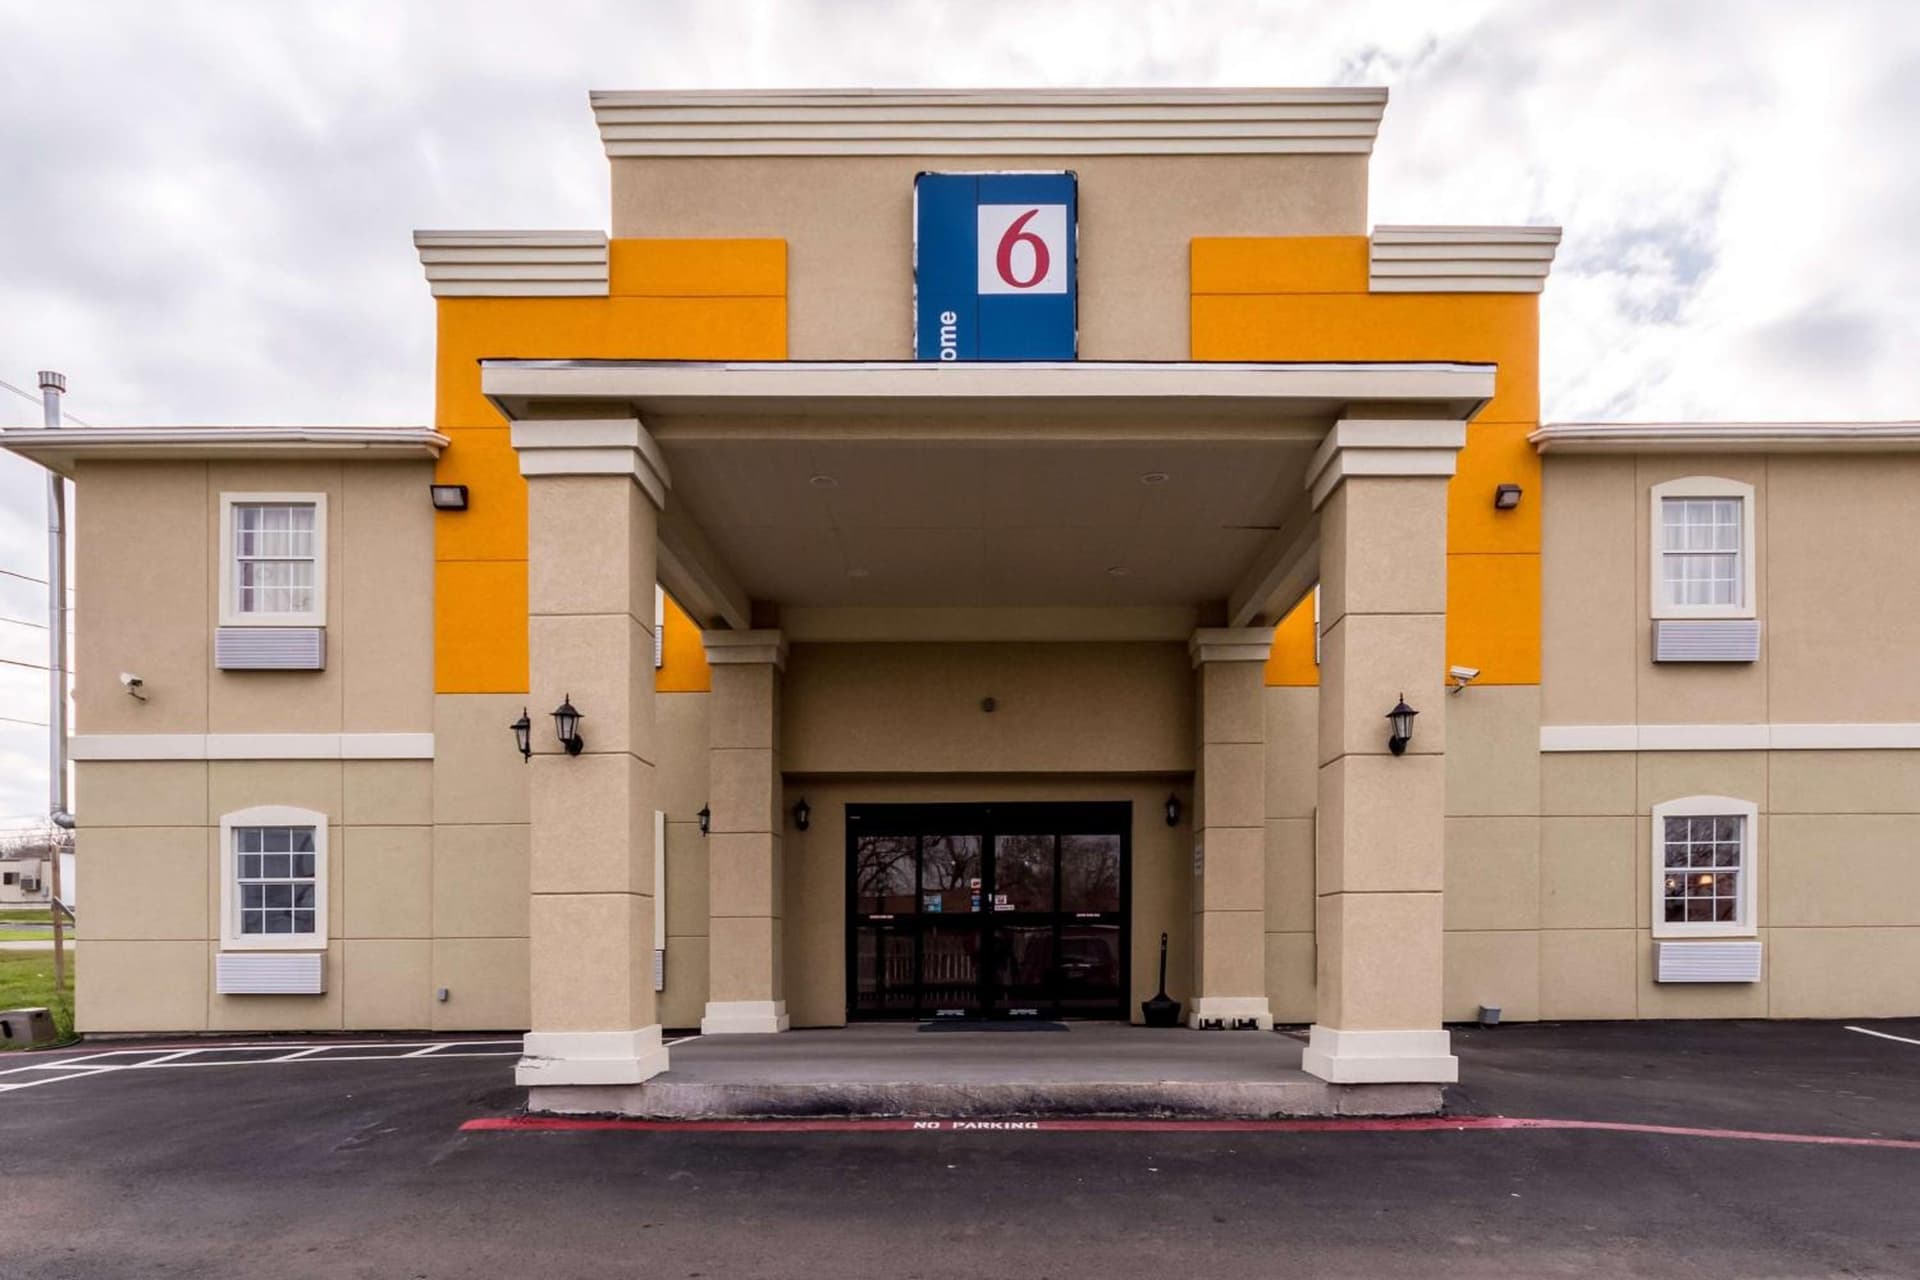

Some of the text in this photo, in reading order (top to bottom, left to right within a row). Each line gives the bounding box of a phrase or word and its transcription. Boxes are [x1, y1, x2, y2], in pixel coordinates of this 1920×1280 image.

[996, 209, 1050, 288] 6
[913, 1121, 1039, 1129] NO PARKING
